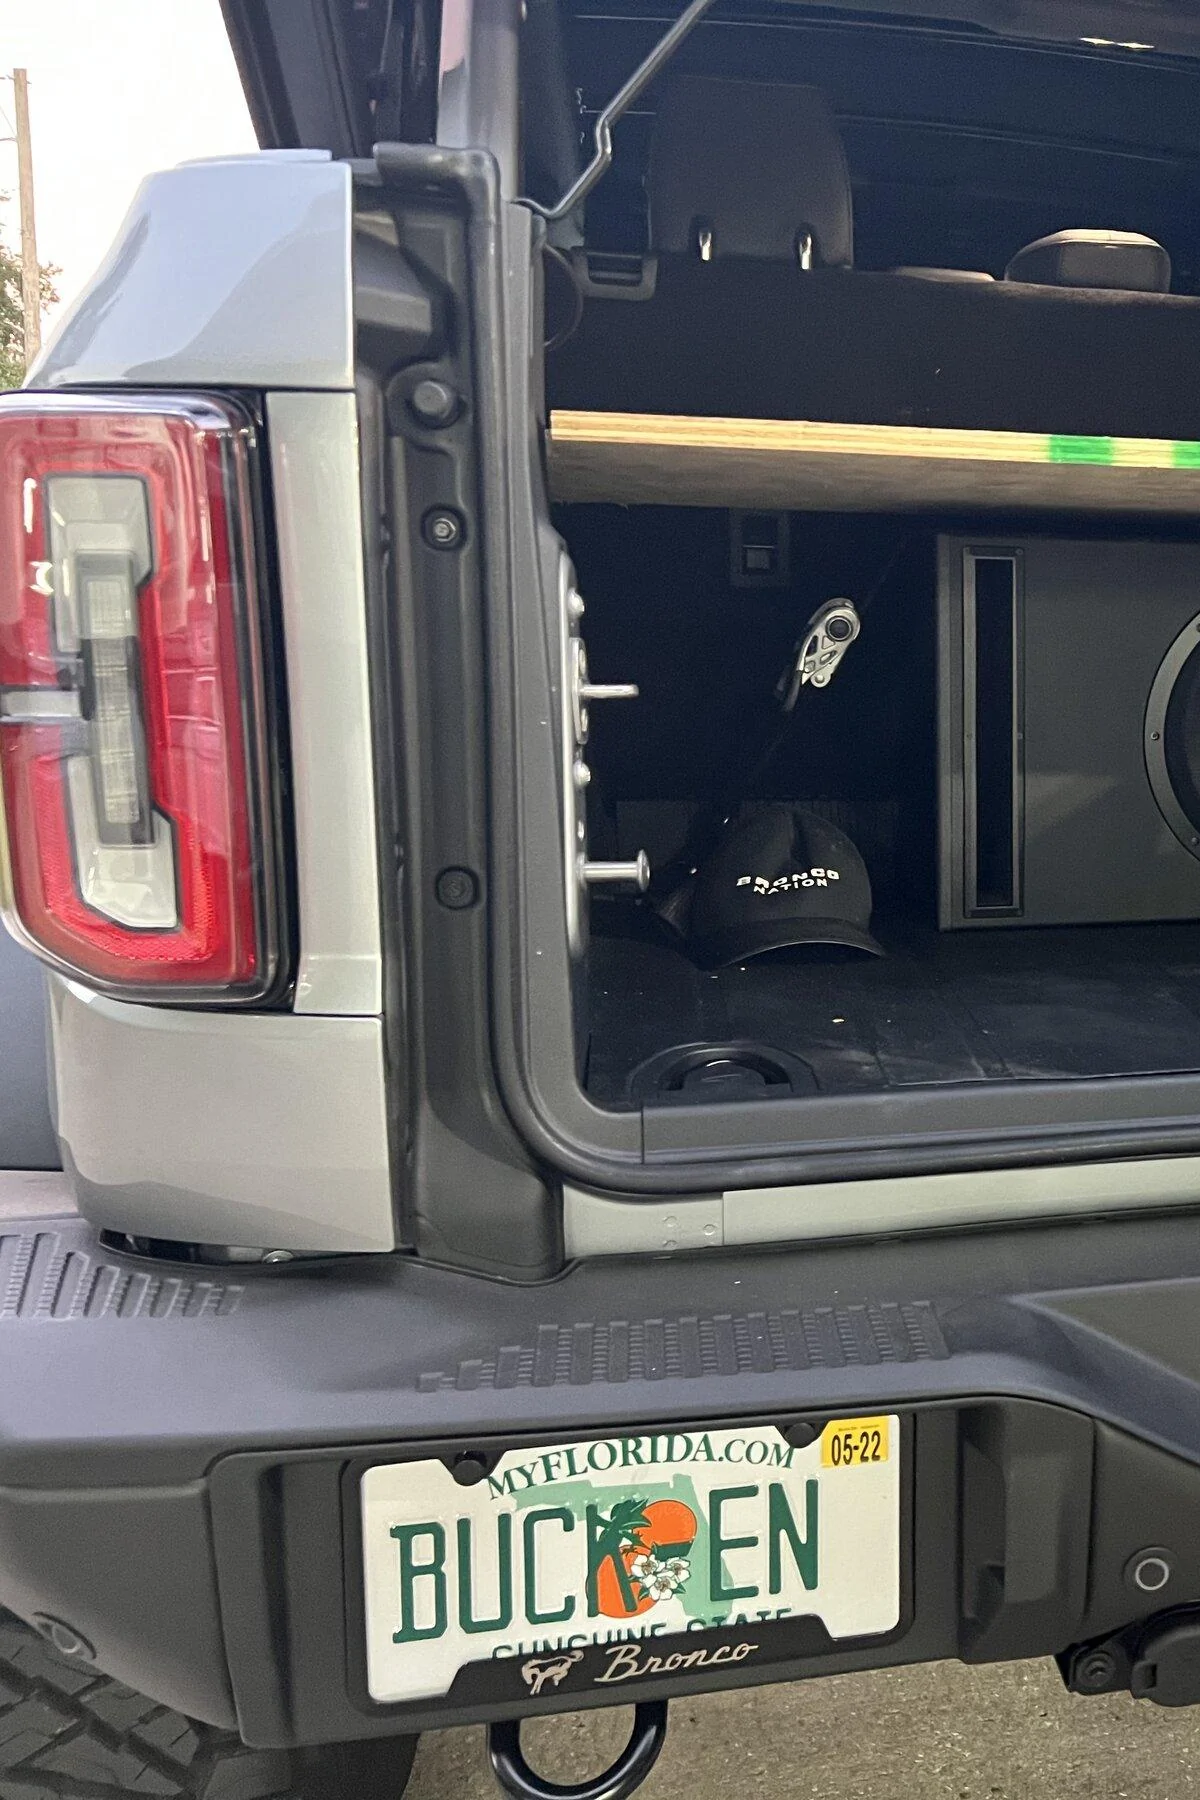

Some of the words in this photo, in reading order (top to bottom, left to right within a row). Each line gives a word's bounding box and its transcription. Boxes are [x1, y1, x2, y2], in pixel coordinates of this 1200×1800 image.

[736, 868, 840, 888] BRONCO
[753, 878, 828, 895] NATION
[831, 1430, 881, 1466] 05-22
[487, 1434, 796, 1500] MYFLORIDA.COM
[594, 1643, 759, 1683] Bronco
